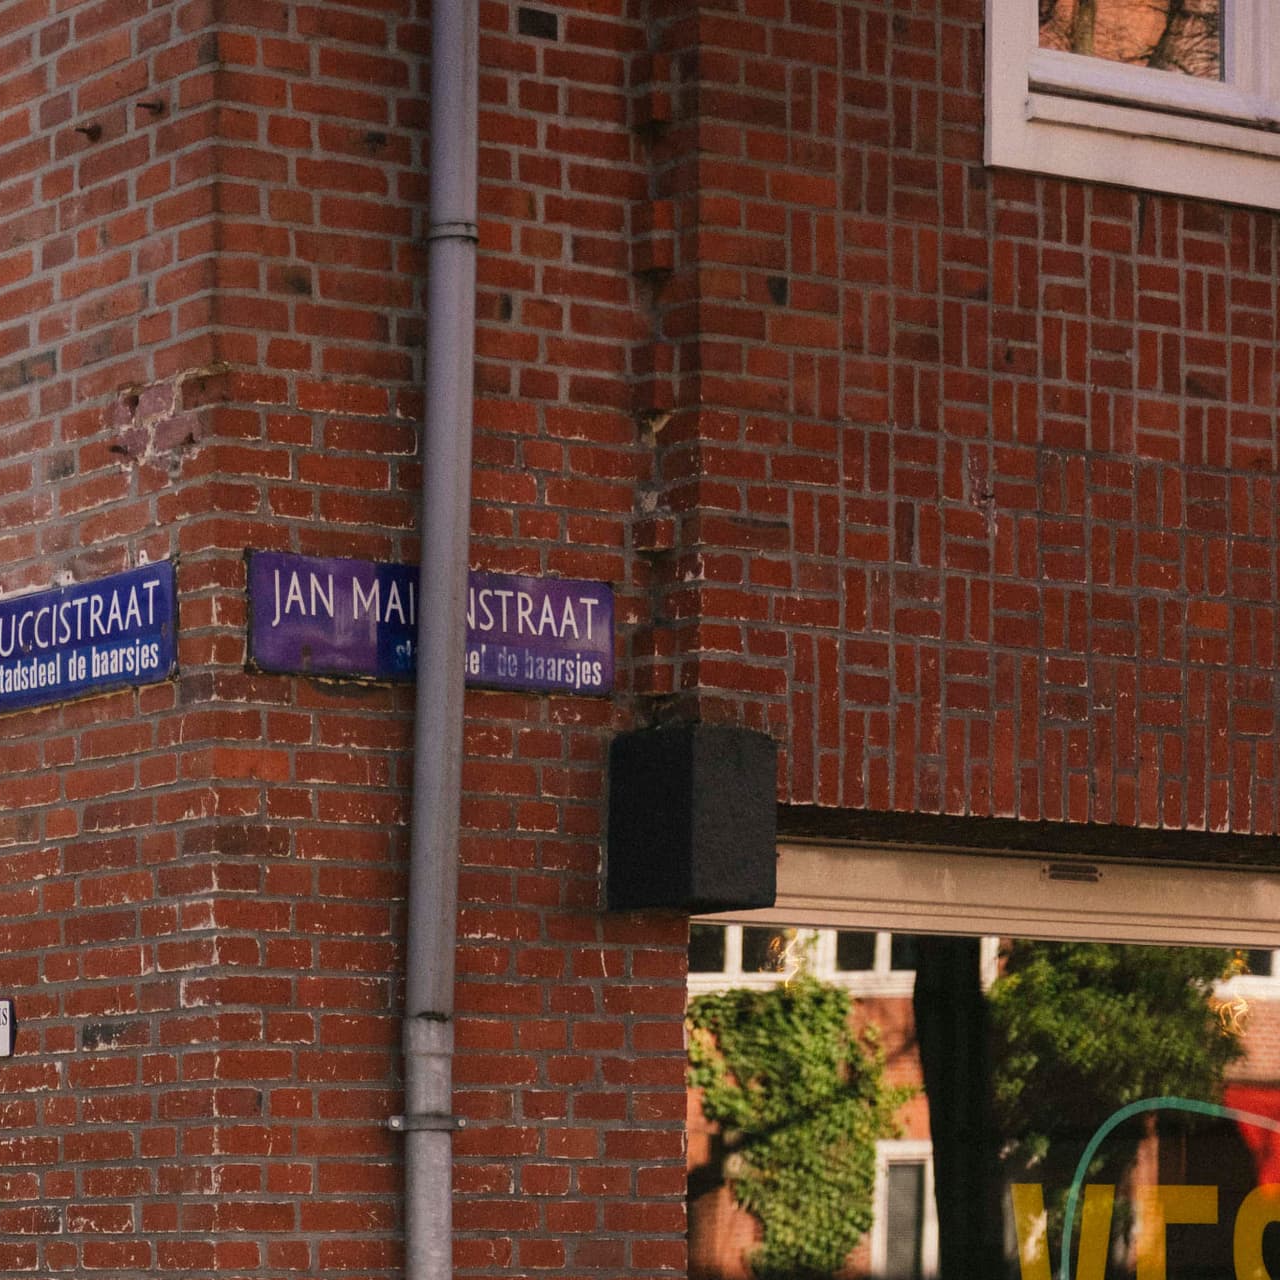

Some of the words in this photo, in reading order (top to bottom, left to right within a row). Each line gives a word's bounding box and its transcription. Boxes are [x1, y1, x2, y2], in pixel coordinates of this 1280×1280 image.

[272, 568, 334, 628] JAN
[68, 650, 87, 683] de
[92, 638, 159, 678] baarsjes
[498, 646, 518, 678] de
[525, 648, 602, 690] baarsjes
